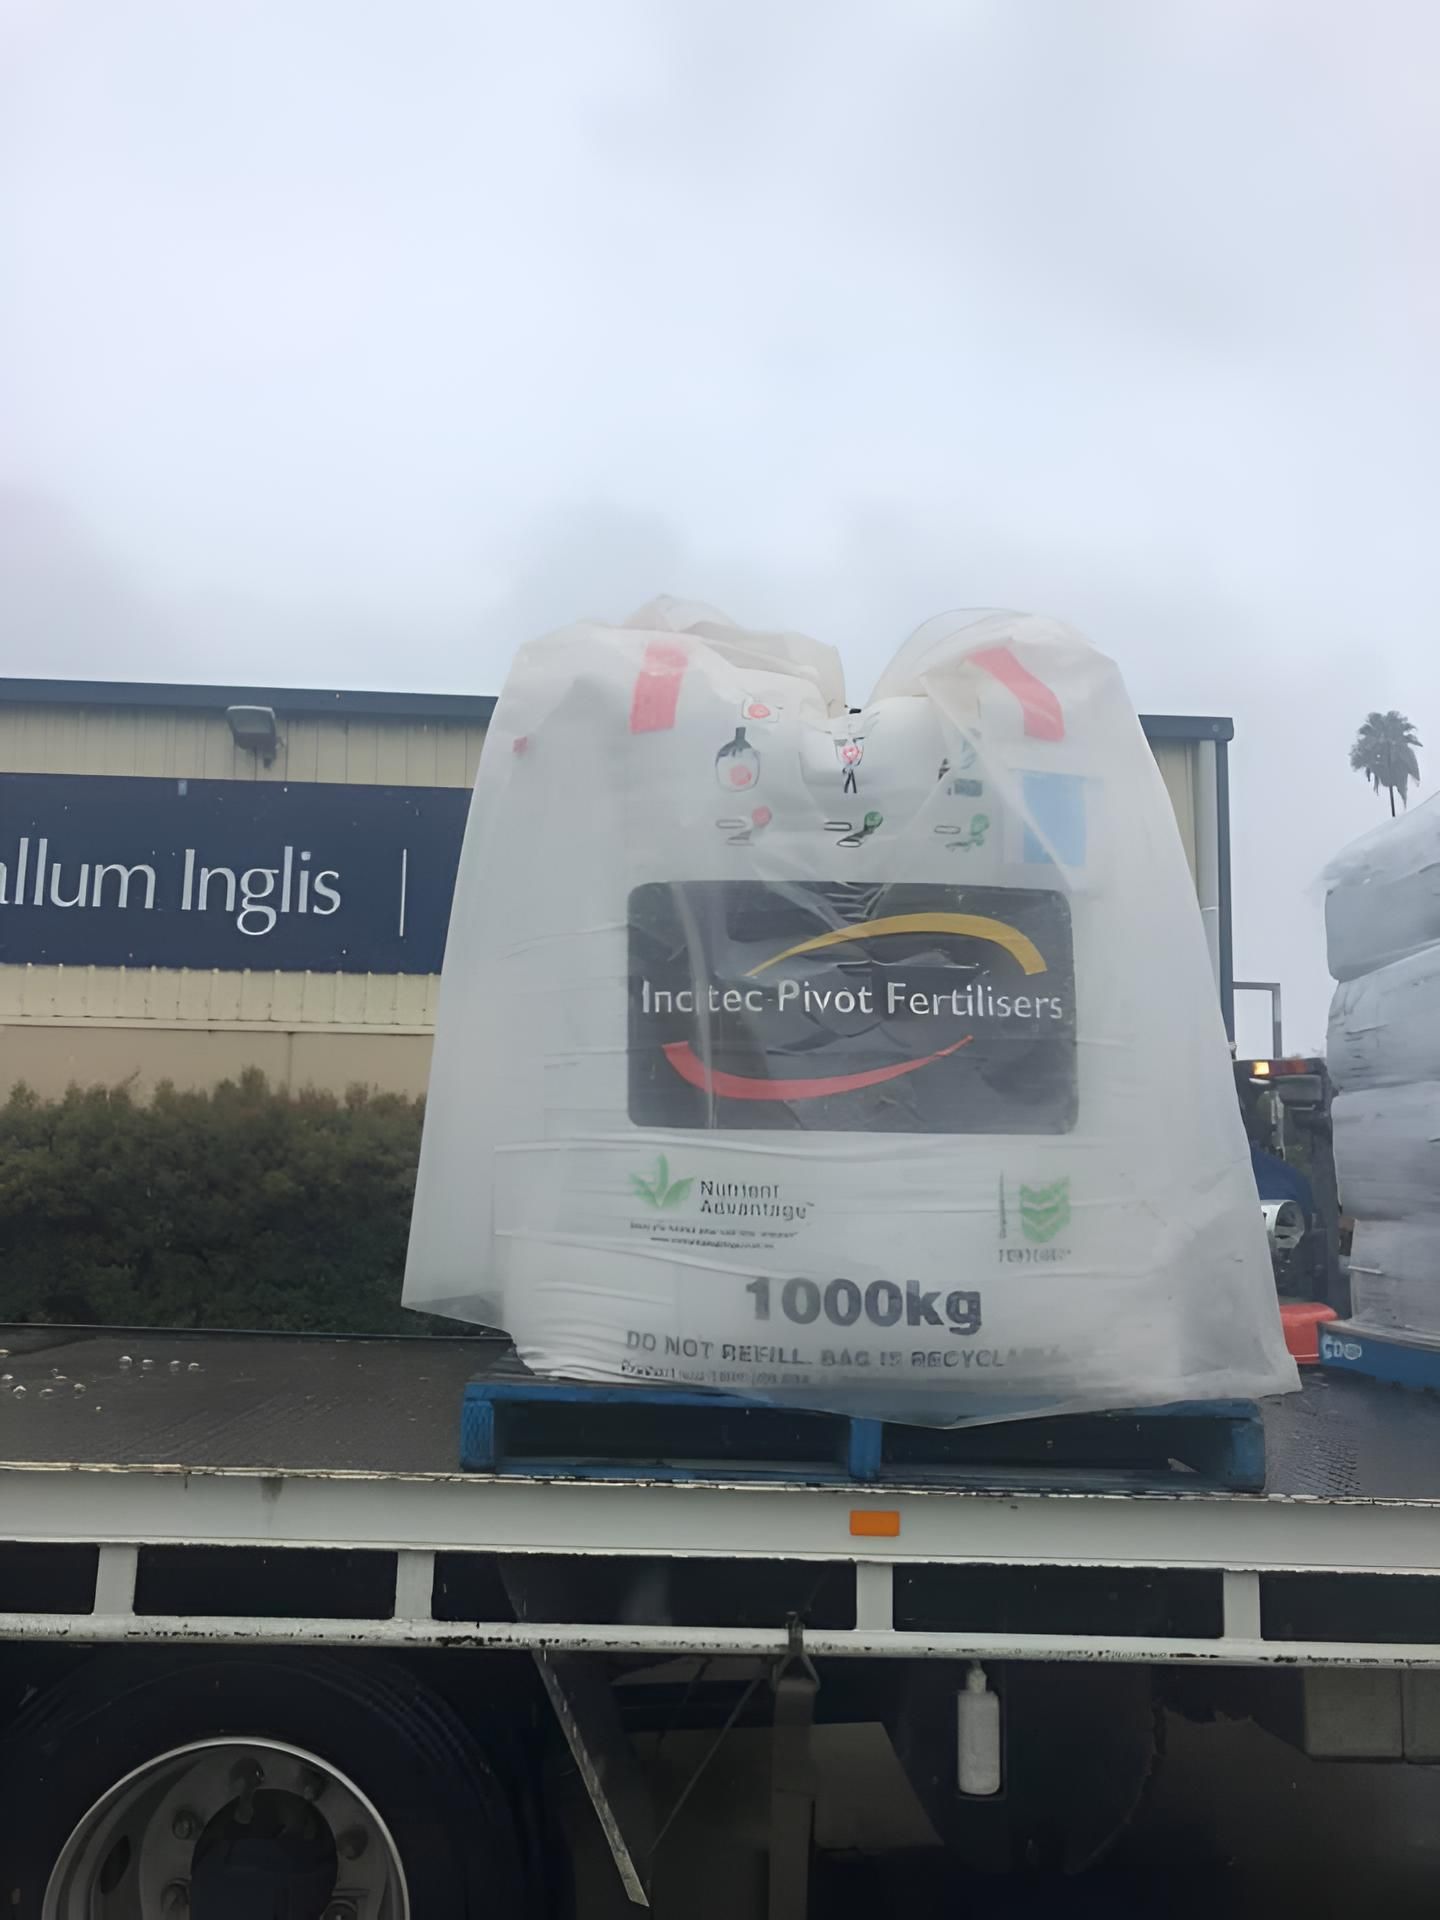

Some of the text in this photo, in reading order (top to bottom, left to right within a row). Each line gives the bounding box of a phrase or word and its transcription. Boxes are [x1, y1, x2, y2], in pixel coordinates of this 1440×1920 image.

[0, 838, 341, 936] llum Inglis
[777, 979, 873, 1014] Pivot
[887, 982, 1063, 1019] Fertilisers
[746, 1276, 982, 1336] 1000kg
[626, 1331, 656, 1351] DO
[664, 1335, 714, 1358] NOT
[820, 1348, 871, 1367] BAG
